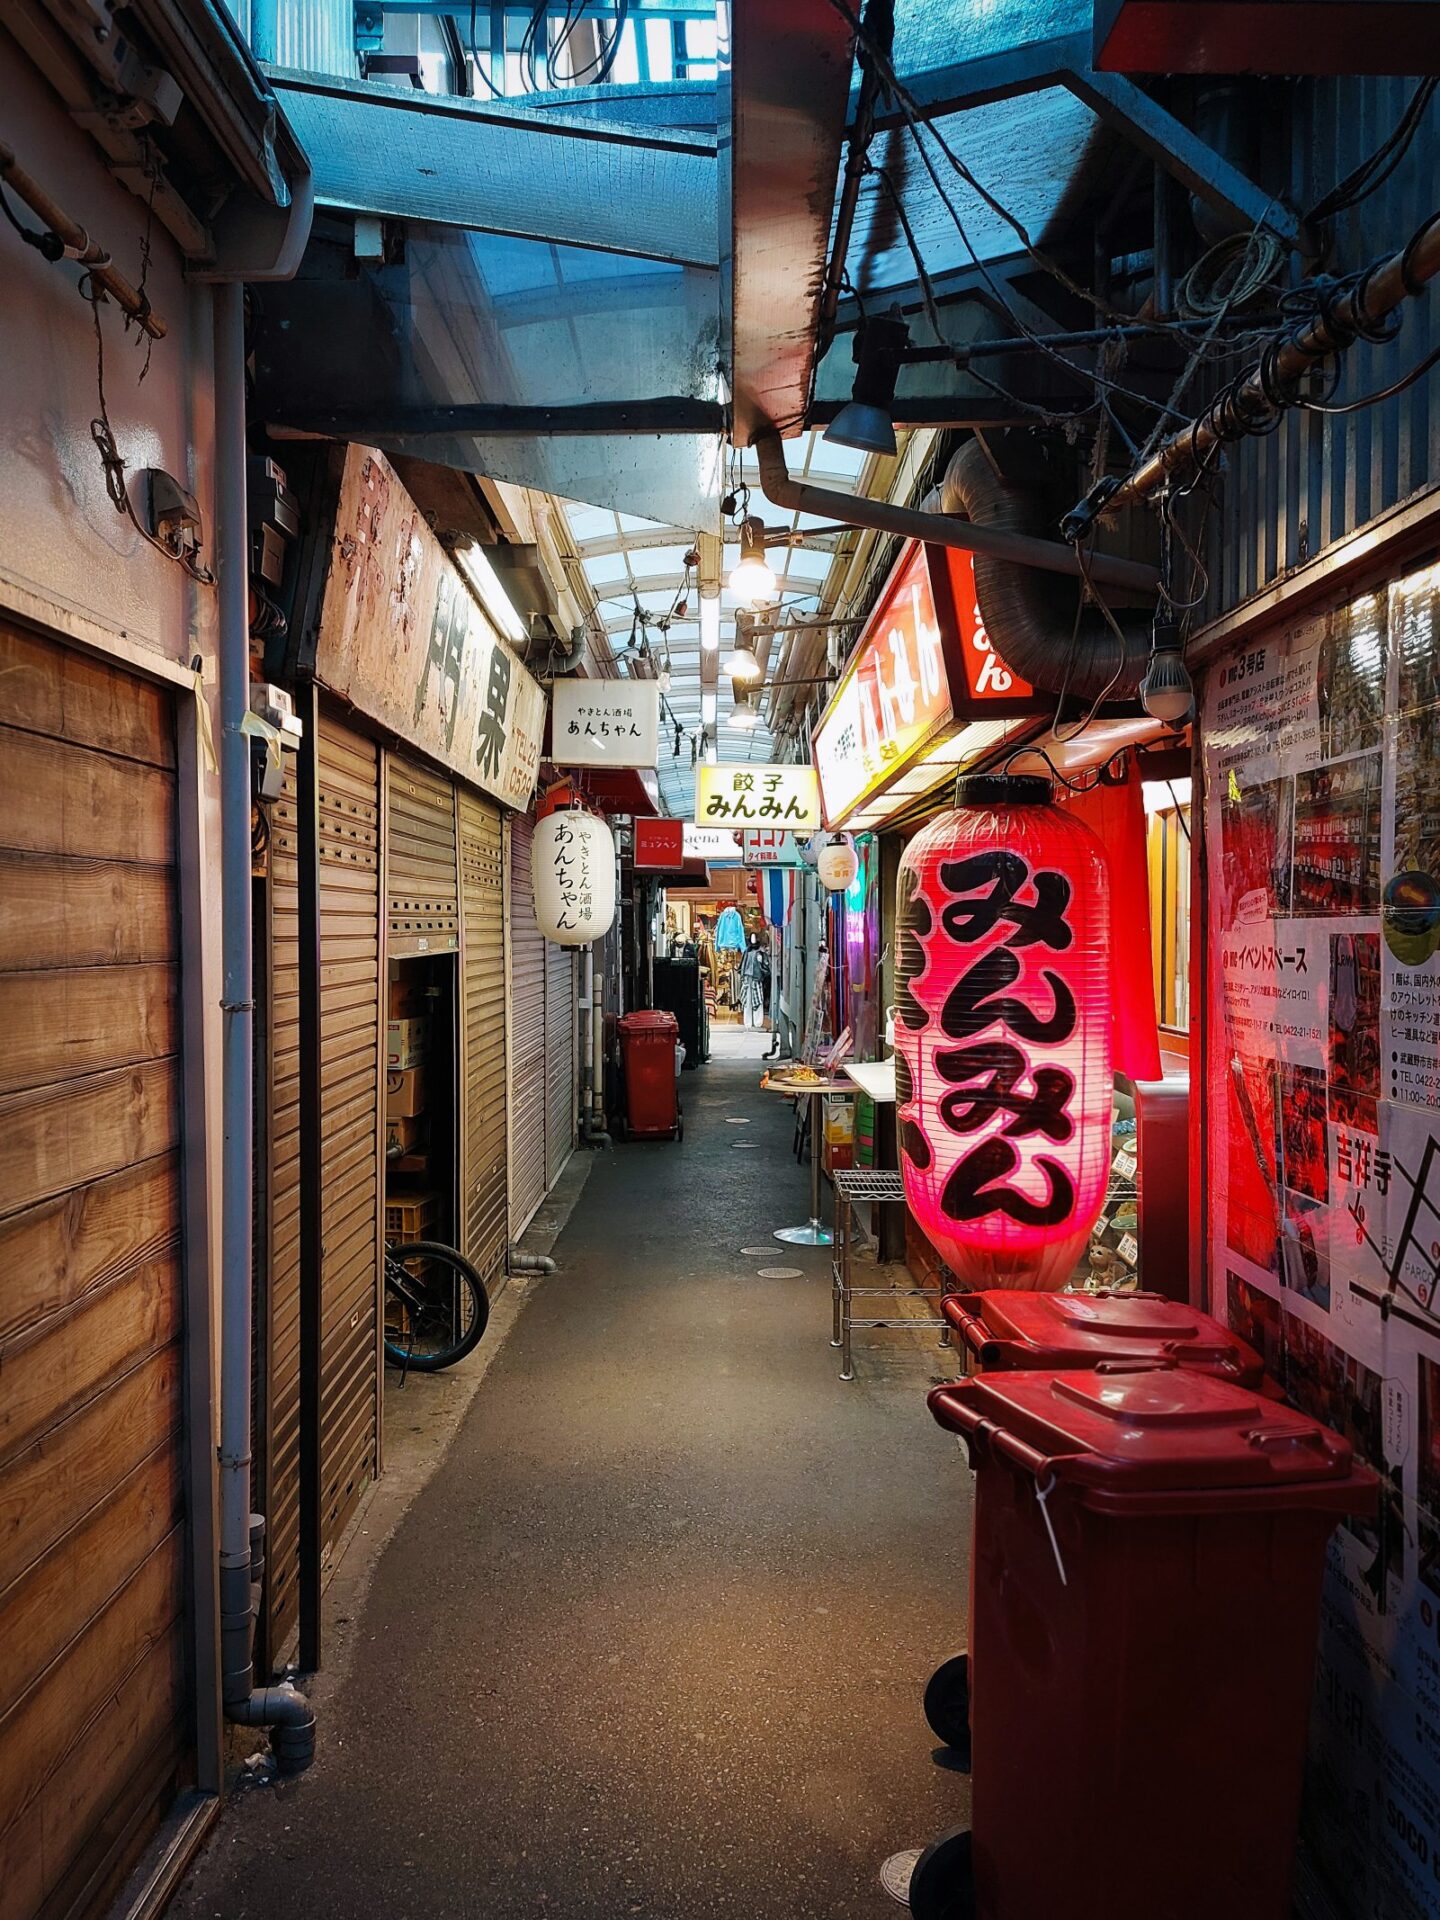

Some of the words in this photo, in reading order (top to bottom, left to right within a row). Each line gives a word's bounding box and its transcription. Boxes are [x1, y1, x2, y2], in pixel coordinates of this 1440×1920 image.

[577, 707, 633, 717] やきとん酒場
[567, 720, 642, 737] あんちゃん
[514, 728, 528, 762] TEL
[733, 772, 784, 792] 餃子
[706, 794, 809, 819] みんみん
[640, 841, 677, 849] ミュンヘン
[554, 823, 578, 930] あんちゃん
[578, 831, 593, 921] やきとん酒場
[1239, 945, 1308, 974] イベントスペース
[935, 850, 1077, 1228] みんみん
[1400, 1070, 1413, 1083] TEL
[1336, 1133, 1392, 1196] 吉祥寺
[1404, 1261, 1434, 1287] PARCO
